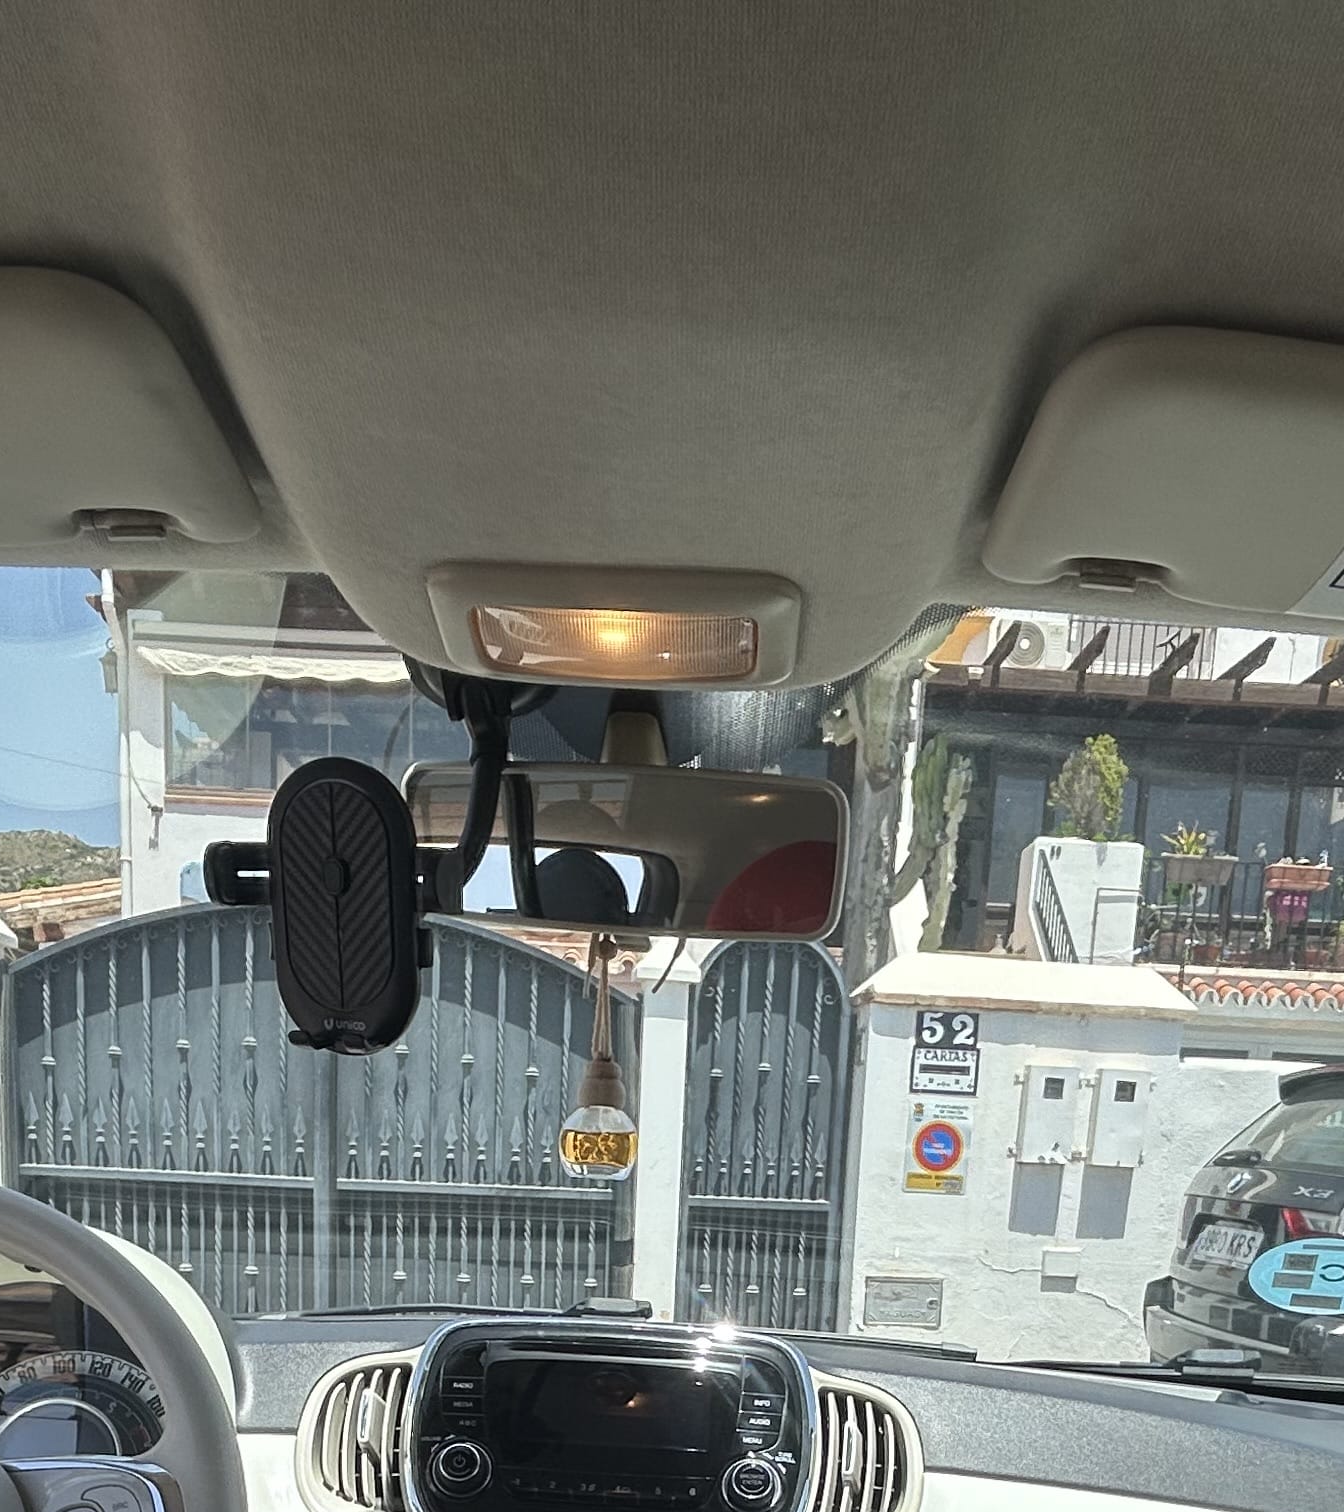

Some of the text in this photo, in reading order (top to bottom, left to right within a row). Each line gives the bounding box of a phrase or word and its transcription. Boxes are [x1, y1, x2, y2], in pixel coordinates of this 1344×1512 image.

[921, 1012, 975, 1045] 52
[923, 1050, 968, 1062] CARTAS
[17, 1366, 37, 1384] 80
[53, 1359, 75, 1374] 100
[88, 1359, 112, 1378] 120
